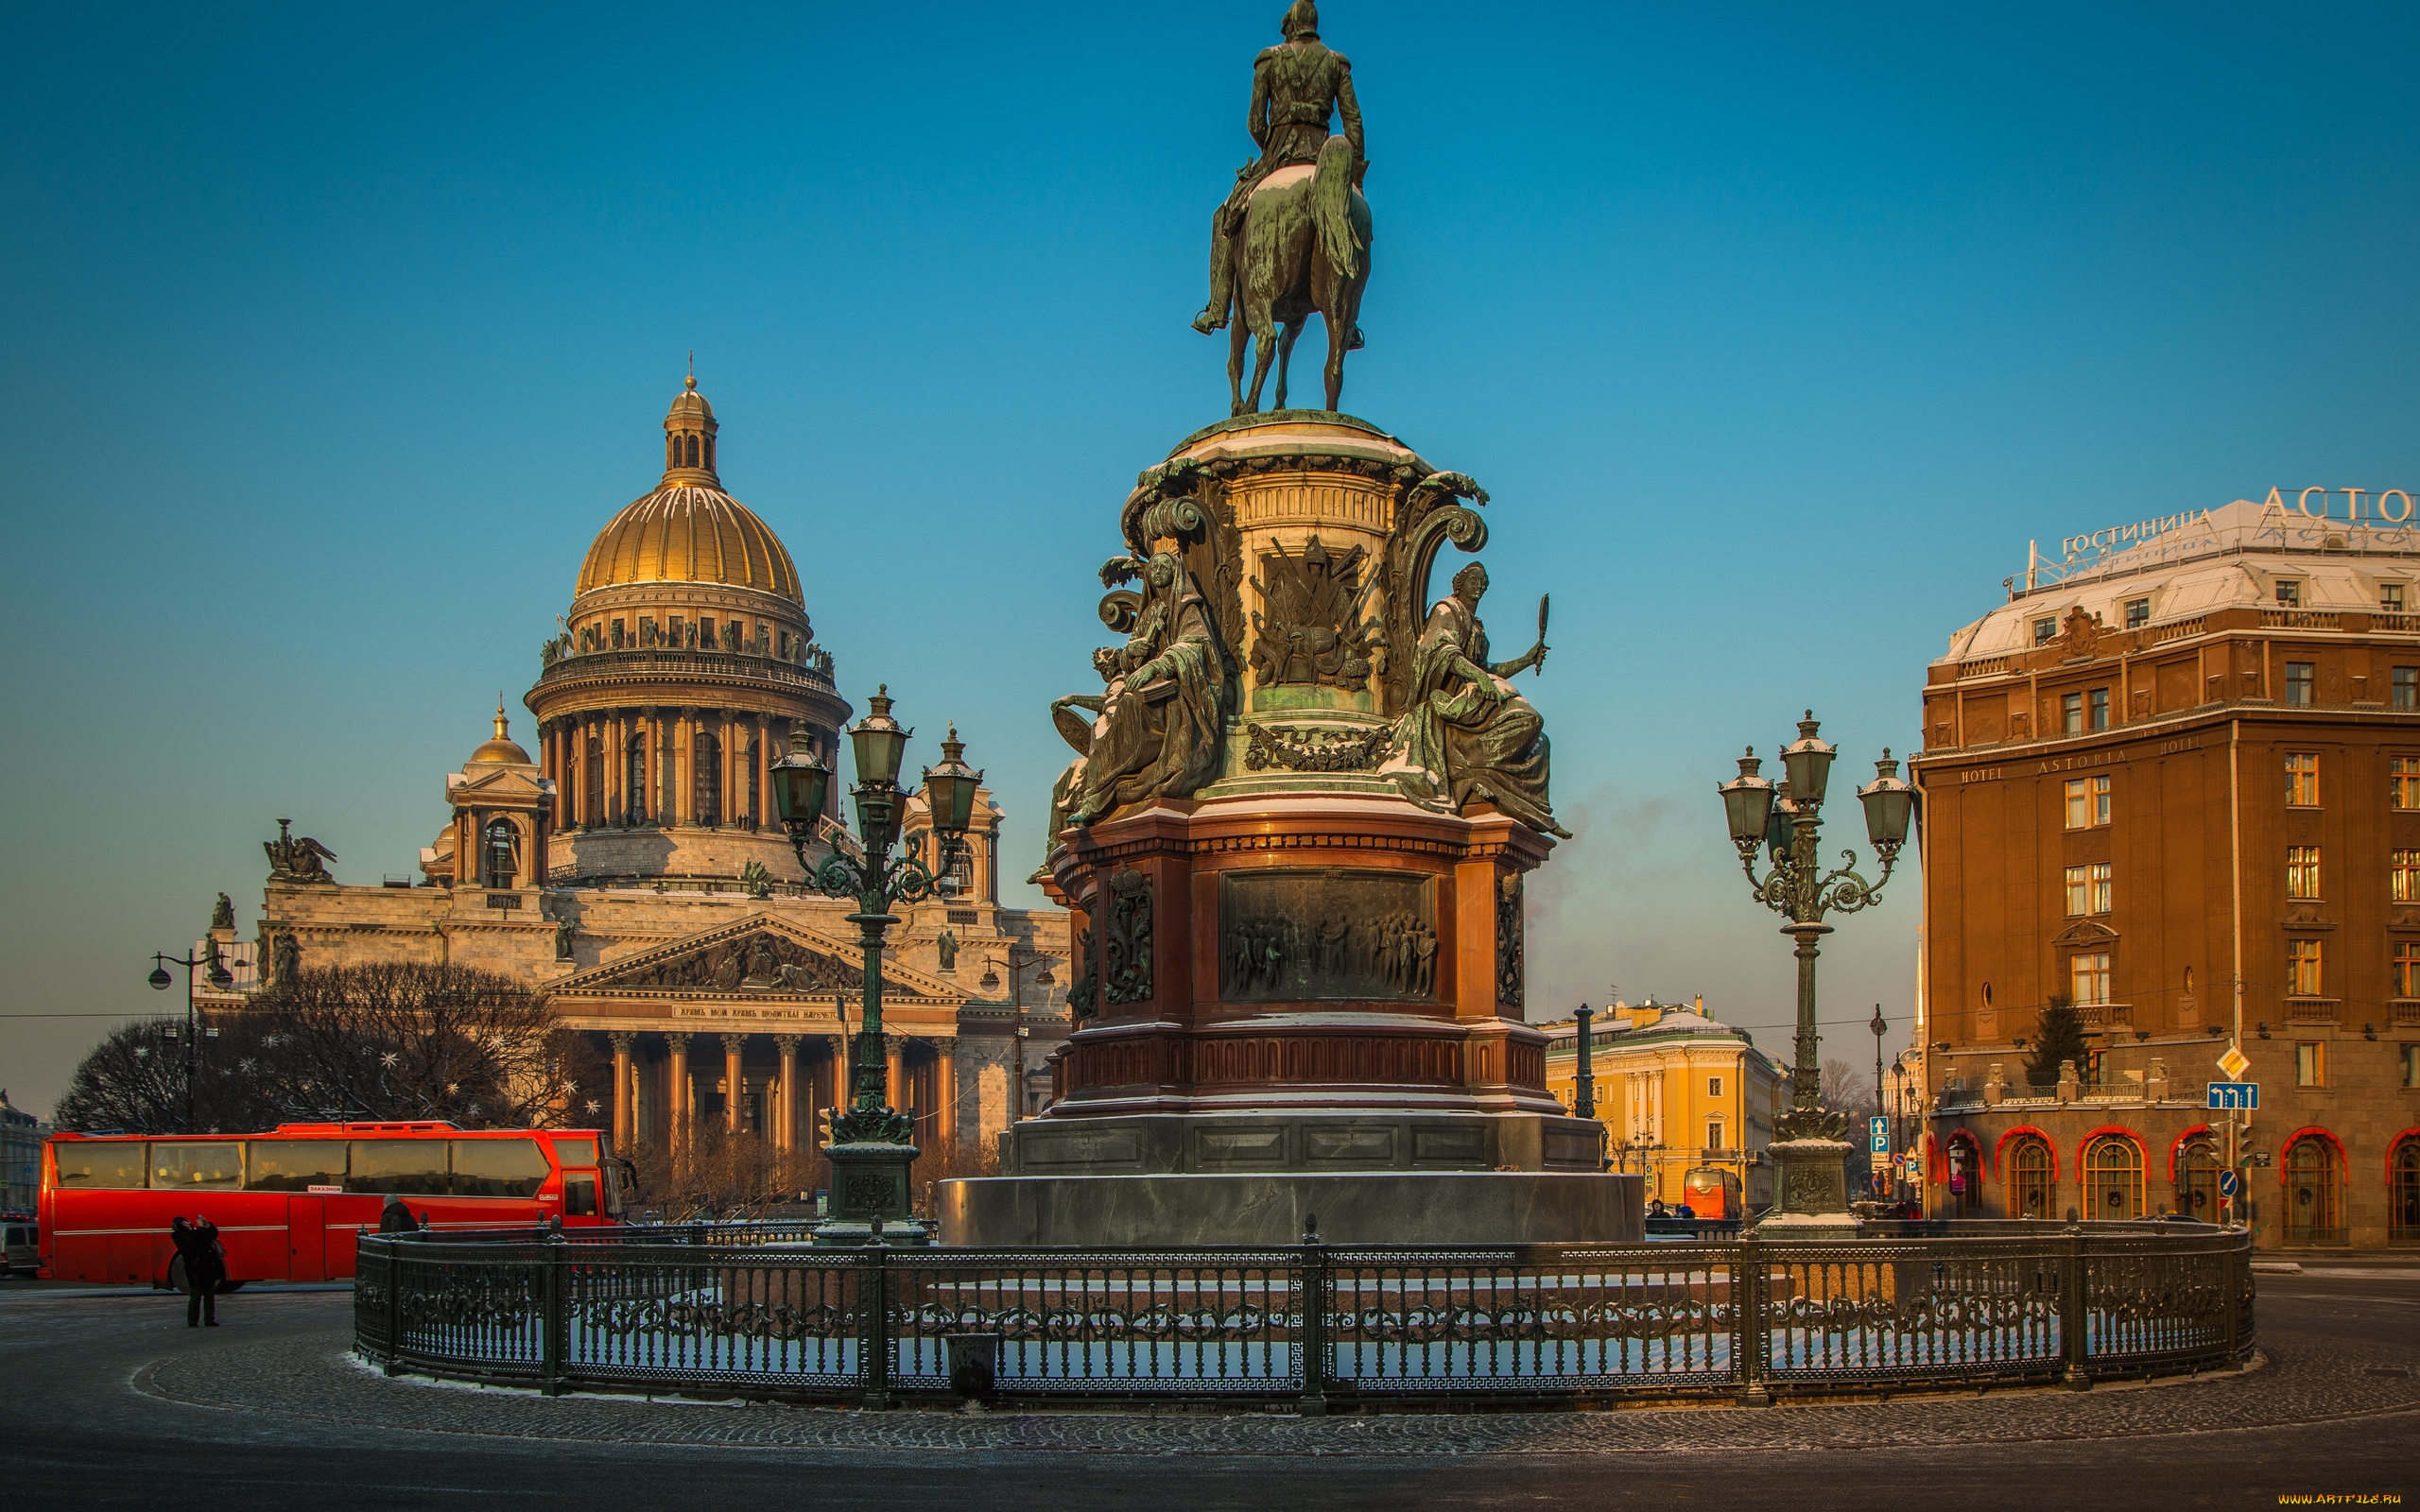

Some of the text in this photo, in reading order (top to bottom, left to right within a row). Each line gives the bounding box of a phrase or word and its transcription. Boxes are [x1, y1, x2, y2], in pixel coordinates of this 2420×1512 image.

[2258, 486, 2411, 523] АСТО
[2064, 507, 2212, 556] ГОСТИНИЦА
[1962, 736, 2202, 783] HOTEL ASTORIA HOTEL
[681, 1007, 706, 1017] ХРАМЪ
[732, 1008, 757, 1018] ХРАМЪ
[1876, 1137, 1886, 1151] P
[1909, 1161, 1916, 1171] P
